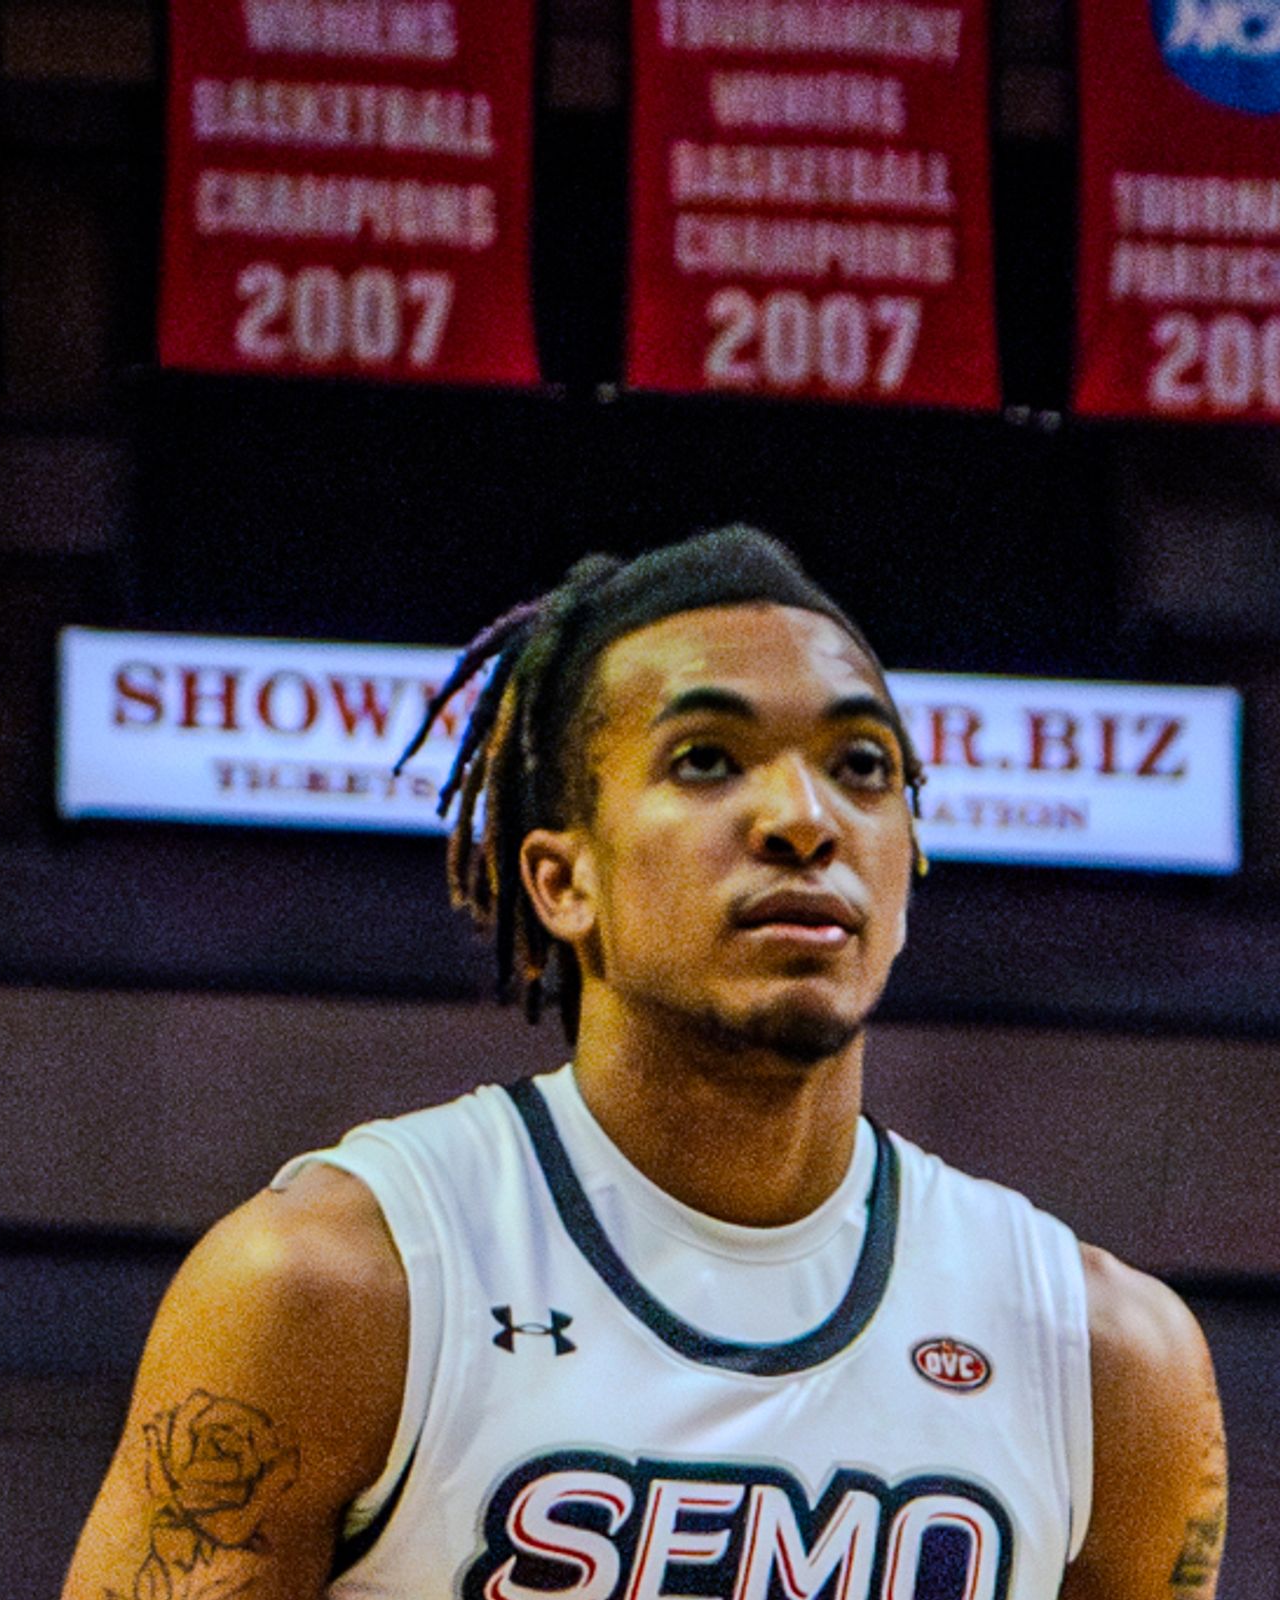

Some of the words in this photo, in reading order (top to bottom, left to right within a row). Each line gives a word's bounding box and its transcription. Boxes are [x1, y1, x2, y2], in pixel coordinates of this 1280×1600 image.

[194, 166, 498, 252] CHAMPIONS
[232, 258, 458, 371] 2007
[702, 284, 925, 395] 2007
[922, 1343, 980, 1382] OVC
